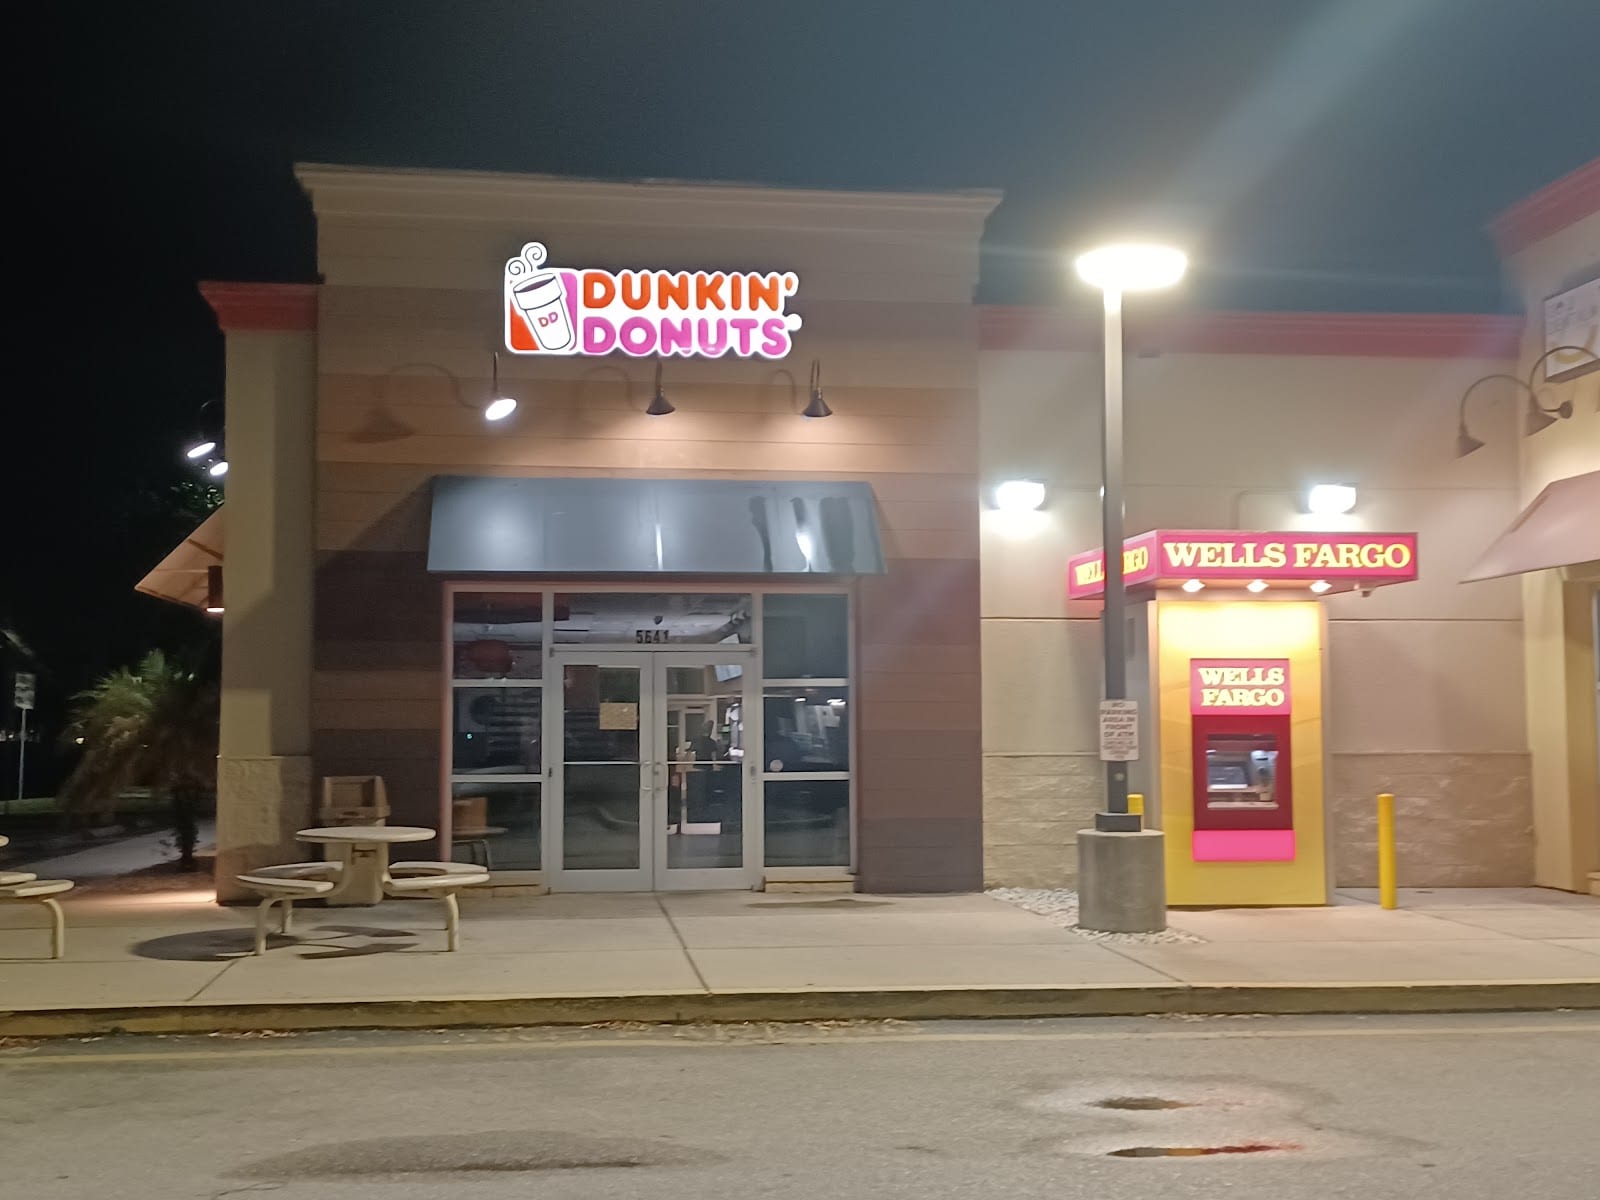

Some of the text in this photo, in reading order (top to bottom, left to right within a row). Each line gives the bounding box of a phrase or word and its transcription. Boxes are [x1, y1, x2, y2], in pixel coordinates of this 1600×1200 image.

[583, 271, 792, 311] DUNKIN'
[538, 311, 559, 328] DD
[583, 316, 789, 356] DONUTS
[1163, 542, 1411, 568] WELLS FARGO
[636, 630, 669, 644] 5641
[1198, 667, 1285, 686] WELLS
[1200, 687, 1285, 707] FARGO
